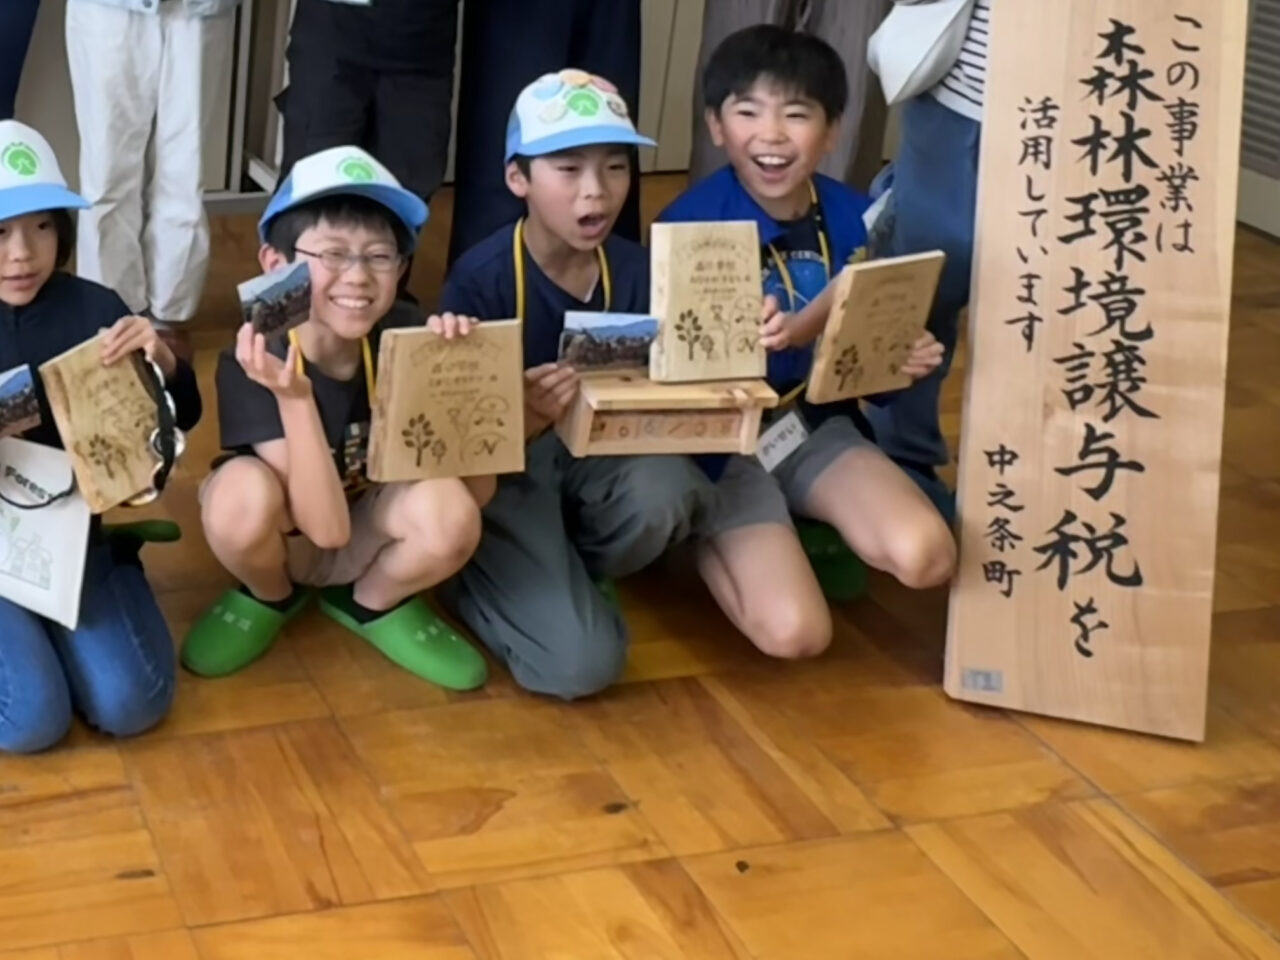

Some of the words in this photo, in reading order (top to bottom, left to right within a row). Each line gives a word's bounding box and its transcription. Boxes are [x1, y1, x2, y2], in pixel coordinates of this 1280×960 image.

[1005, 96, 1061, 352] 活用しています
[1155, 13, 1203, 254] この事業は
[1032, 17, 1166, 658] 森林環境譲与税を
[4, 465, 54, 500] Fores
[981, 443, 1026, 598] 中之条町
